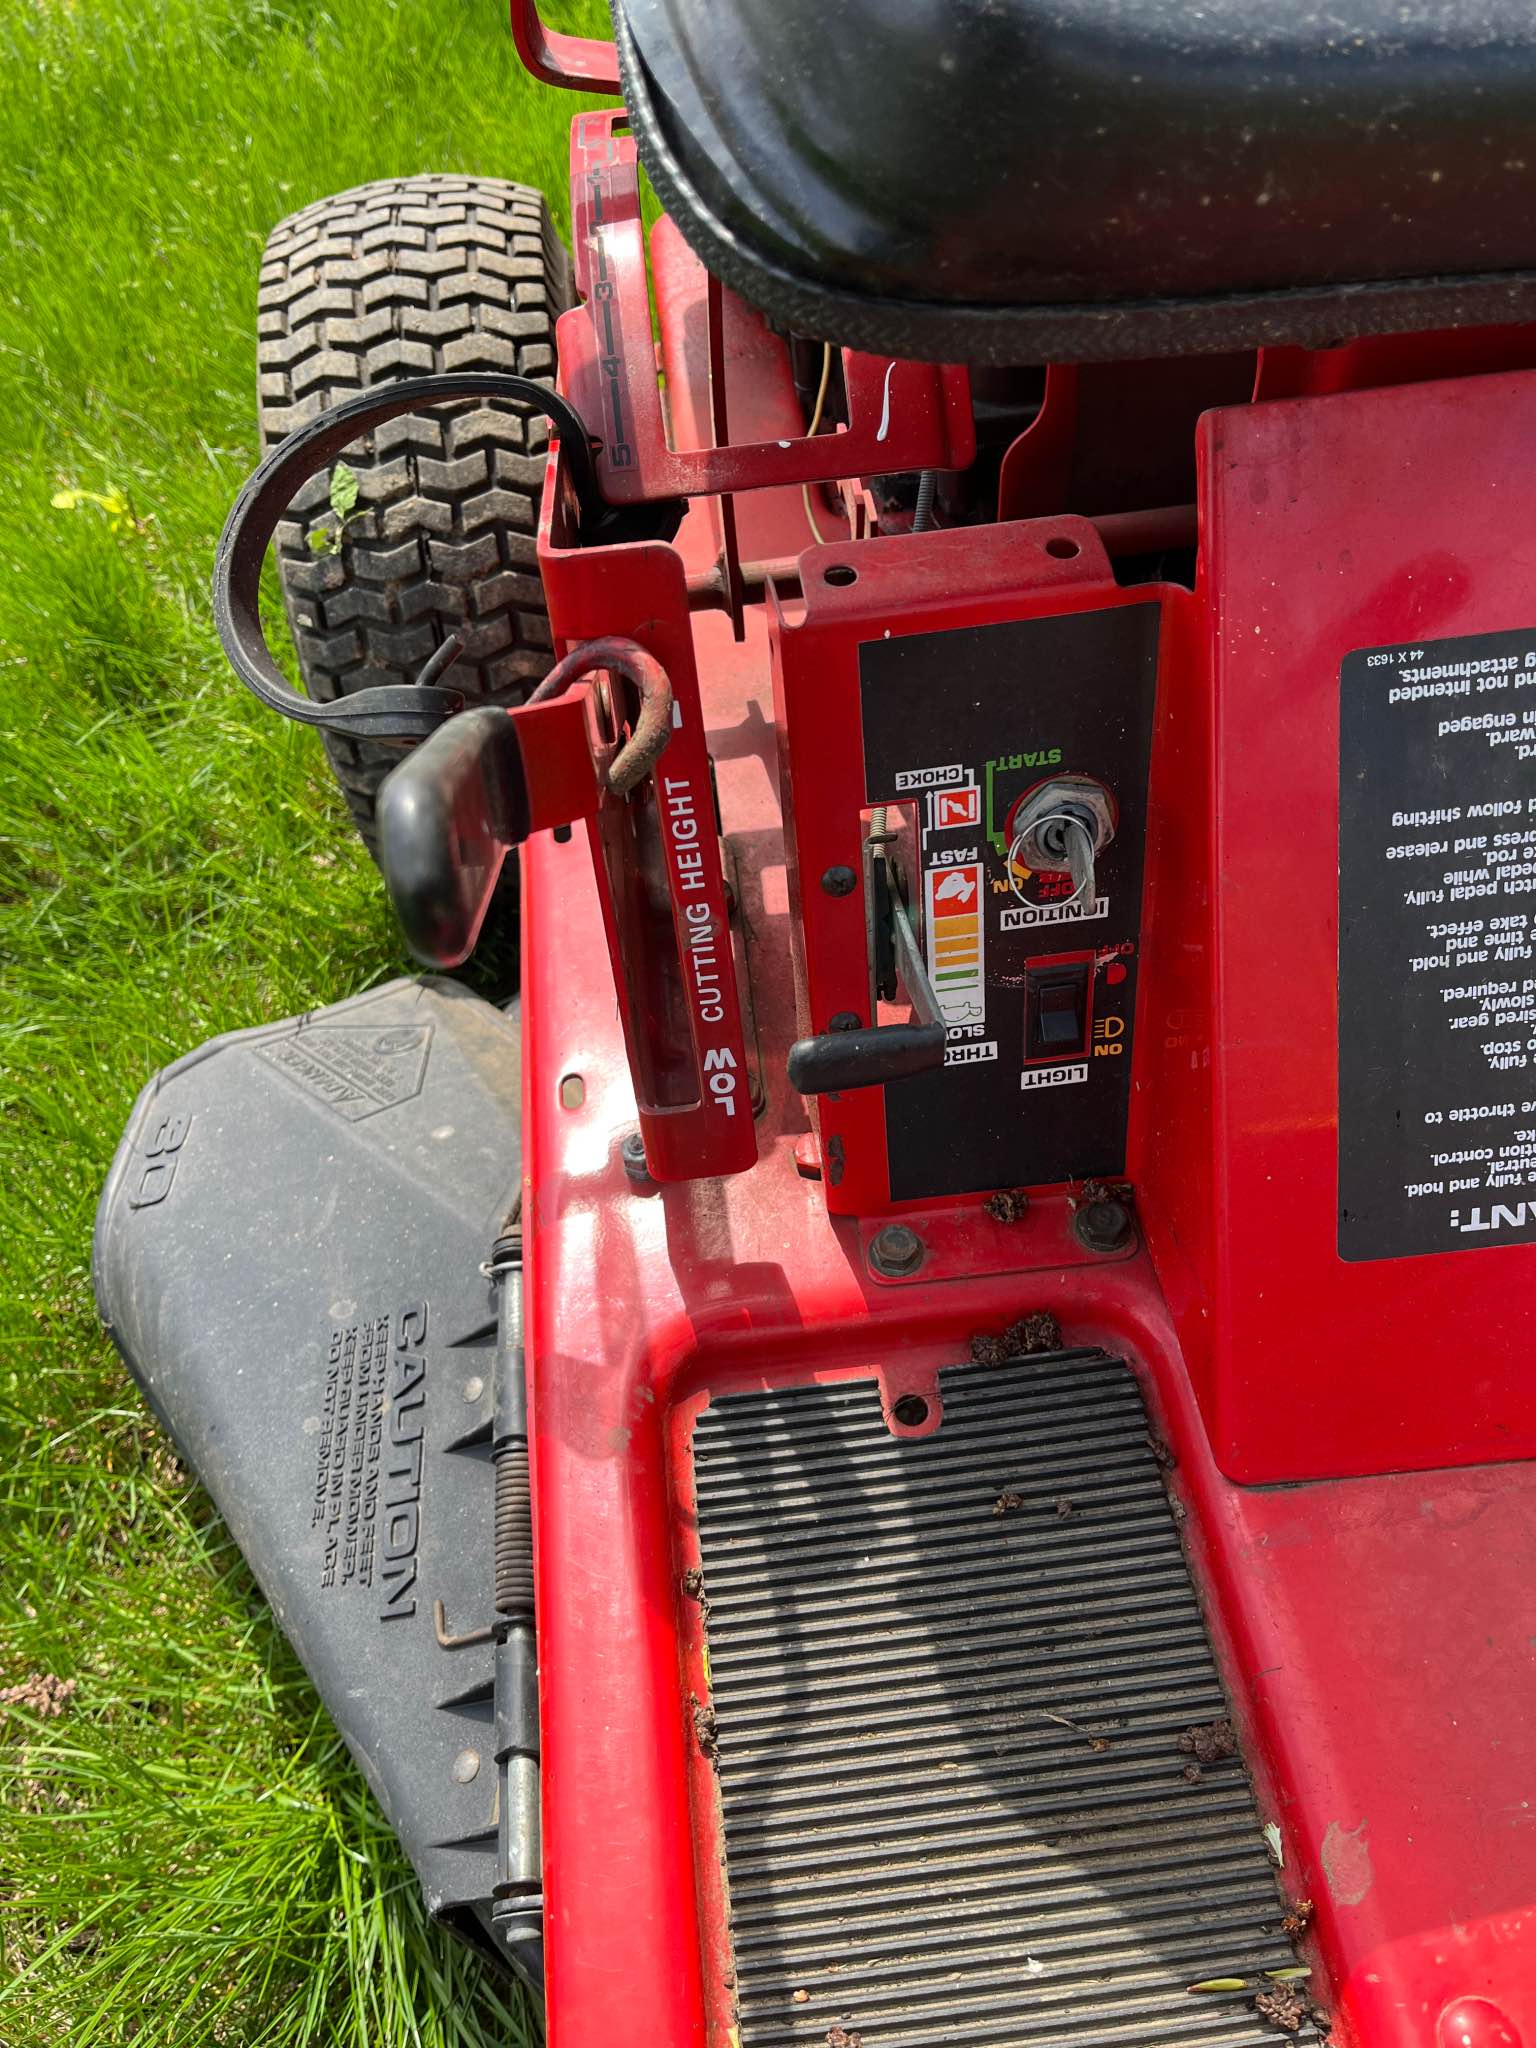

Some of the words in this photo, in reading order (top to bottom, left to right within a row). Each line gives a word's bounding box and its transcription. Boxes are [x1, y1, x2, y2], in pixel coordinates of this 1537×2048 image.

[594, 281, 613, 300] 3
[602, 357, 620, 378] 4
[612, 443, 631, 467] 5
[1367, 653, 1394, 666] 1633
[1398, 651, 1406, 663] X
[1410, 649, 1424, 660] 44
[1399, 656, 1518, 683] attachments.
[1389, 680, 1470, 704] intended
[1477, 675, 1508, 692] not
[1438, 713, 1516, 736] engaged
[996, 748, 1061, 772] START
[899, 767, 960, 787] CHOKE
[1392, 807, 1461, 827] shifting
[1467, 800, 1522, 819] follow
[664, 777, 705, 890] HEIGHT
[1386, 841, 1448, 860] release
[1455, 836, 1487, 853] and
[929, 847, 978, 865] FAST
[1483, 850, 1517, 865] rod.
[992, 877, 1023, 893] ON
[1443, 869, 1489, 885] while
[1403, 889, 1444, 905] fully.
[1450, 881, 1497, 901] pedal
[1426, 919, 1483, 939] effect.
[1490, 915, 1527, 930] take
[1446, 936, 1478, 952] and
[1484, 930, 1524, 946] time
[686, 902, 724, 1023] CUTTING
[1456, 951, 1488, 966] and
[1494, 945, 1532, 961] fully
[1409, 955, 1449, 971] hold.
[1440, 981, 1516, 1002] required.
[1479, 994, 1534, 1012] slowly.
[1448, 1012, 1489, 1030] gear.
[945, 1024, 985, 1040] SLO
[1094, 1043, 1123, 1057] ON
[1480, 1040, 1521, 1056] stop.
[1488, 1054, 1527, 1070] fully.
[703, 1047, 738, 1116] LOW
[1025, 1067, 1085, 1087] LIGHT
[1425, 1112, 1442, 1124] to
[1449, 1103, 1515, 1121] throttle
[1430, 1149, 1493, 1166] control.
[1404, 1181, 1443, 1197] hold.
[1450, 1177, 1480, 1192] and
[1486, 1172, 1522, 1187] fully
[328, 1331, 343, 1364] DO
[358, 1321, 374, 1387] FROM
[374, 1314, 389, 1375] KEEP
[341, 1326, 358, 1385] KEEP
[323, 1366, 340, 1416] NOT
[331, 1387, 352, 1470] GUARD
[368, 1377, 385, 1464] HANDS
[351, 1390, 370, 1474] UNDER
[380, 1299, 428, 1622] CAUTION
[311, 1418, 336, 1529] REMOVE.
[330, 1472, 344, 1498] IN
[362, 1467, 380, 1520] AND
[341, 1476, 362, 1587] MOWER.
[320, 1501, 342, 1589] PLACE
[359, 1523, 376, 1588] FEET
